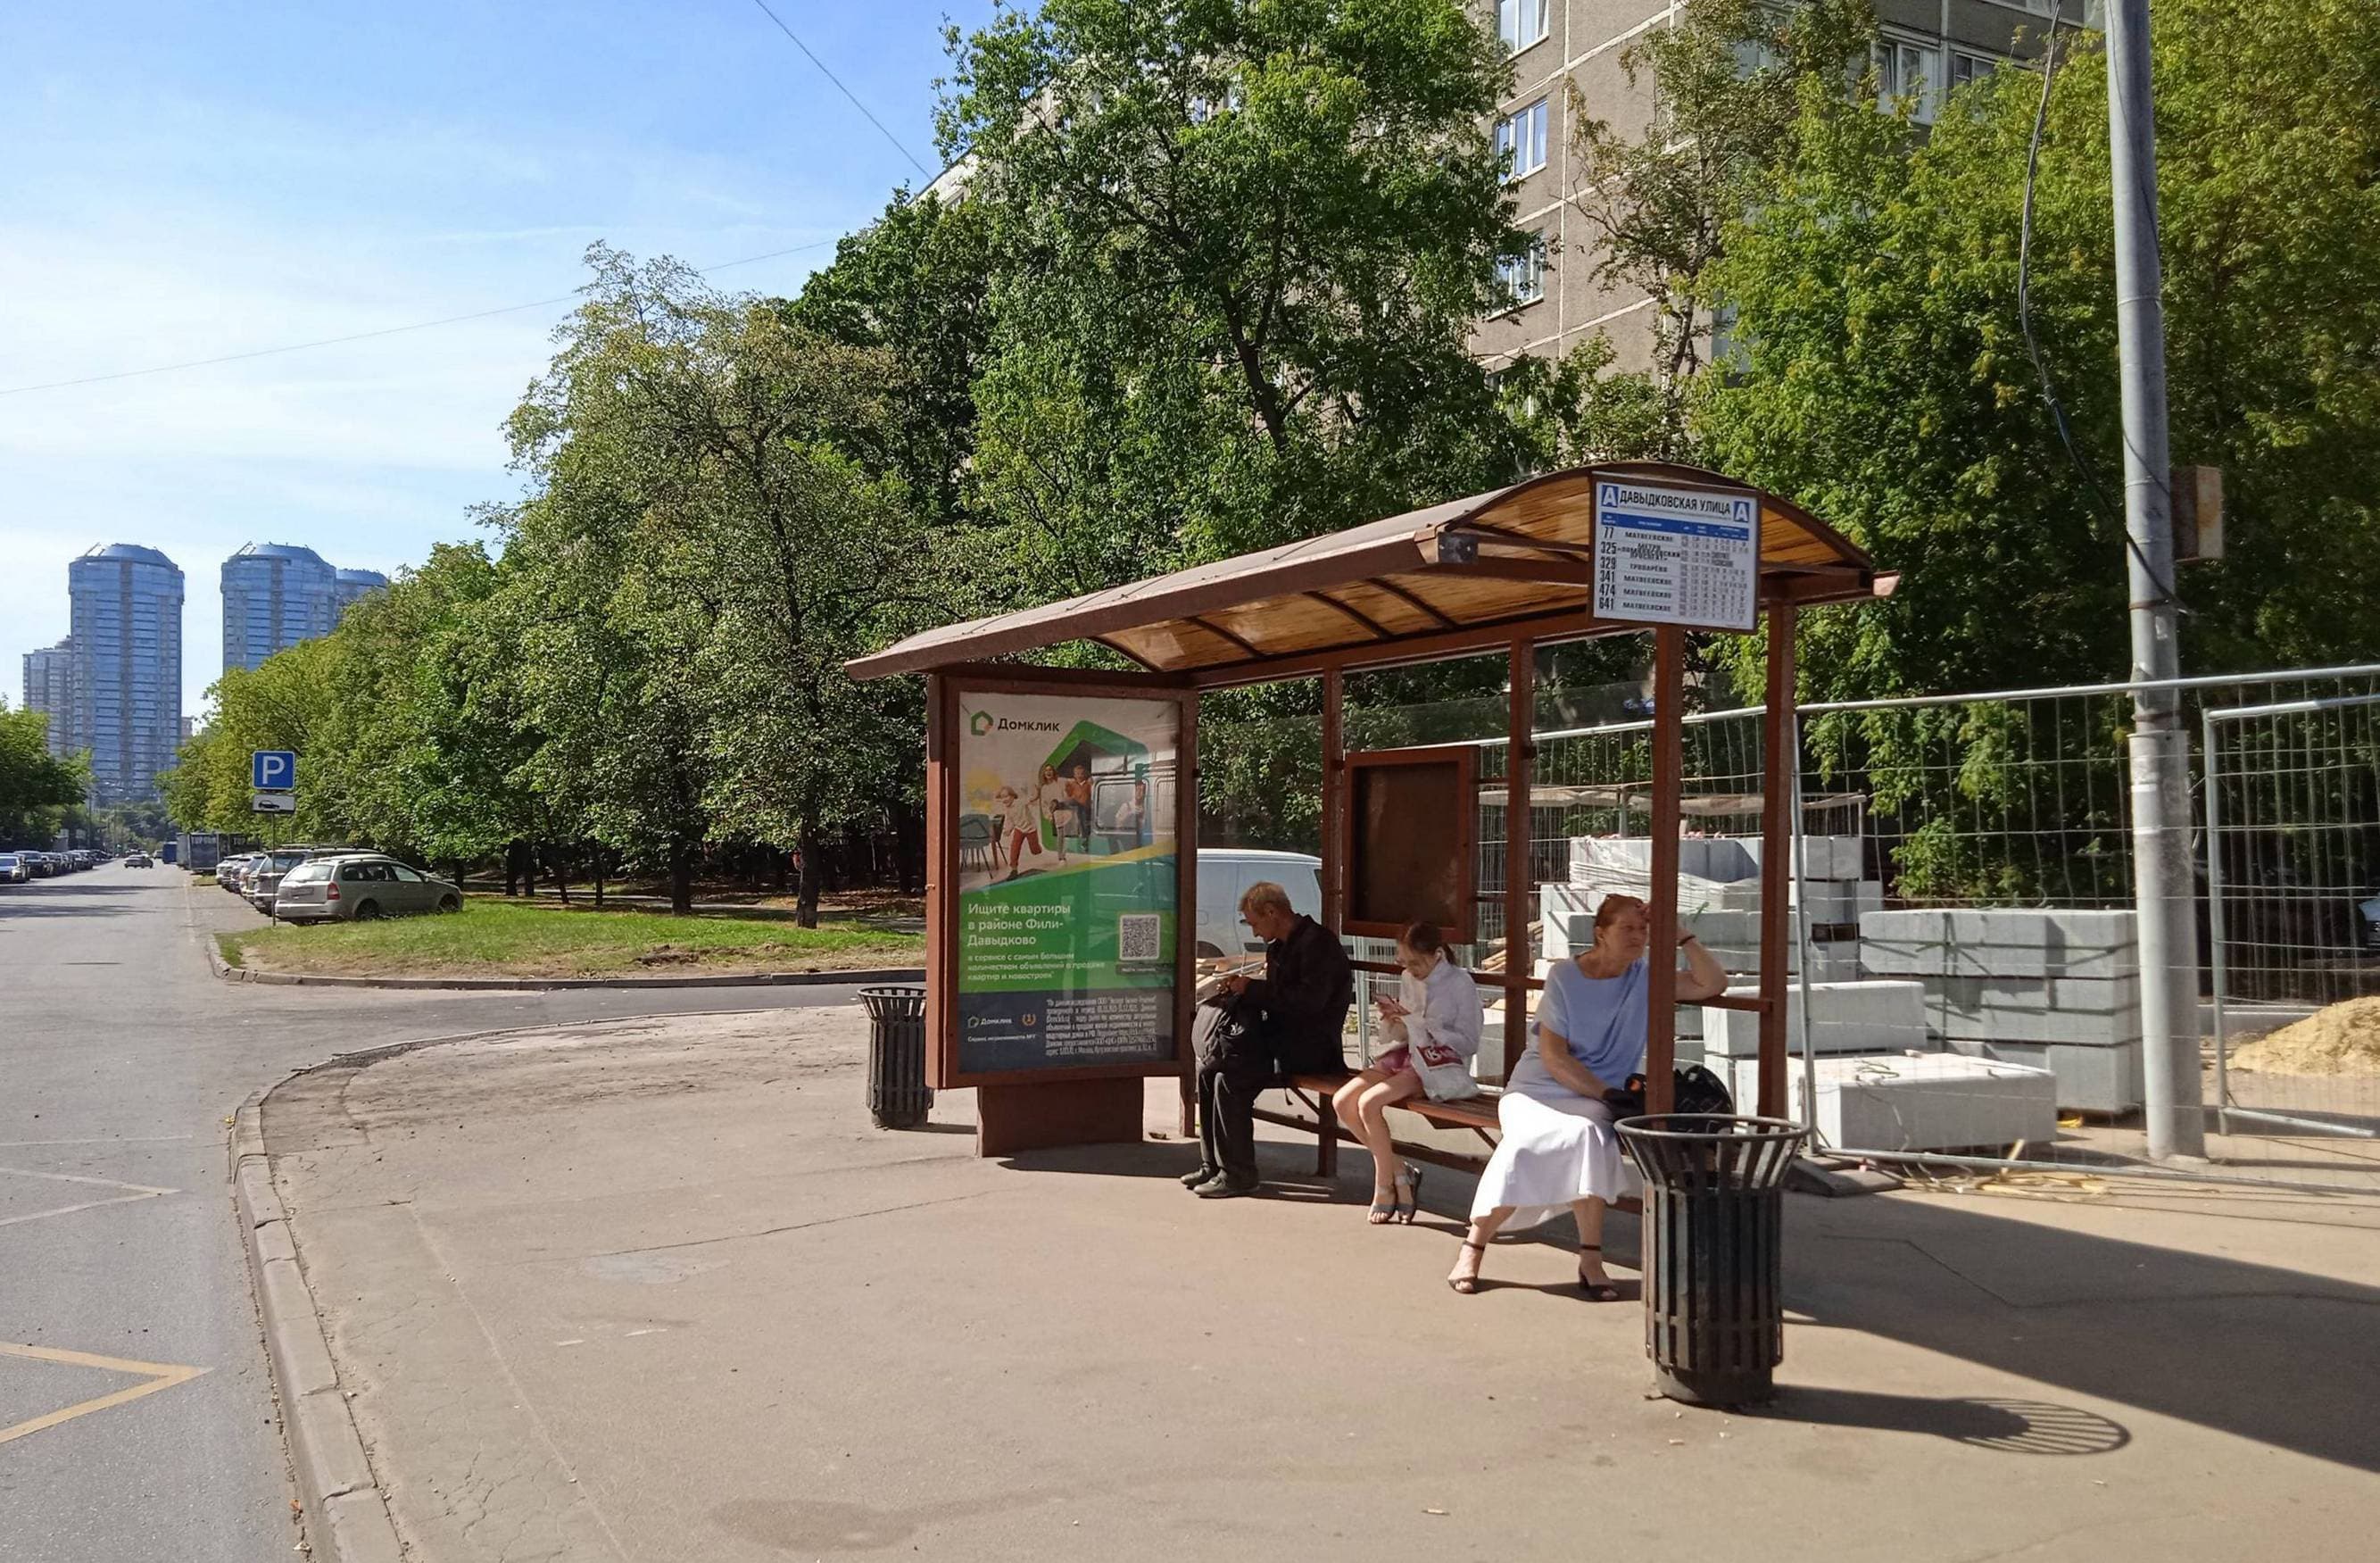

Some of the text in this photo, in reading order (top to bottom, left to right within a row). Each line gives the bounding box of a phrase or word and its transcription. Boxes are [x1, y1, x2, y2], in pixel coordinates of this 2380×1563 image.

[1603, 486, 1618, 506] А
[1620, 490, 1730, 514] ДАВЫДКОВСКАЯ УЛИЦА
[1736, 503, 1749, 521] А
[1605, 527, 1613, 538] 77
[1601, 541, 1616, 554] 325
[1600, 556, 1616, 569] 329
[1599, 569, 1614, 583] 341
[1599, 583, 1615, 596] 474
[1598, 596, 1614, 610] 641
[998, 718, 1060, 732] Домклик
[262, 756, 285, 785] P
[968, 903, 1071, 916] Ищите квартиры
[968, 918, 1064, 932] в районе Фили-
[967, 935, 1036, 947] Давыдково
